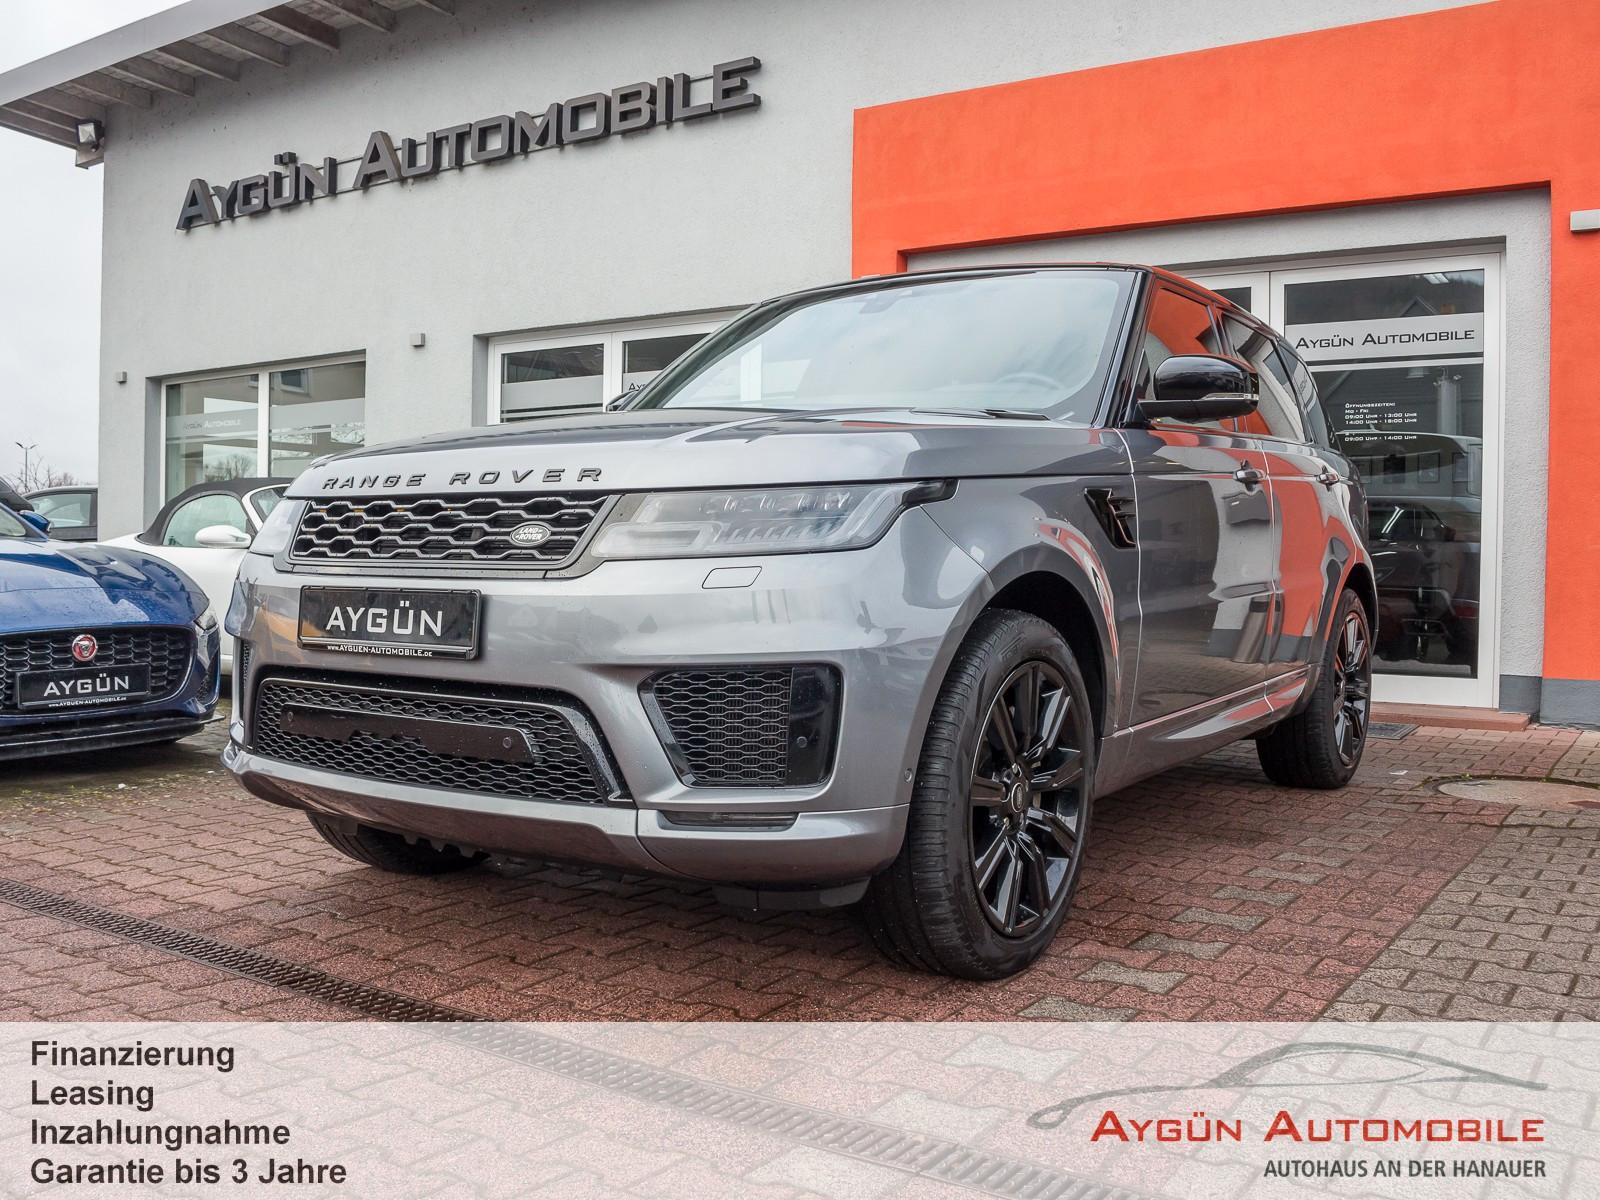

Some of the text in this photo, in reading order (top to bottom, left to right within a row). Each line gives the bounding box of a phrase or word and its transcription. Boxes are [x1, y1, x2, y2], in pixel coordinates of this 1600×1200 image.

[176, 56, 762, 230] AYGÜN AUTOMOBILE
[1295, 329, 1475, 350] AYGÜN AUTOMOBILE
[321, 467, 602, 490] RANGE ROVER
[326, 600, 443, 637] AYGÜN
[44, 673, 129, 696] AYGÜN
